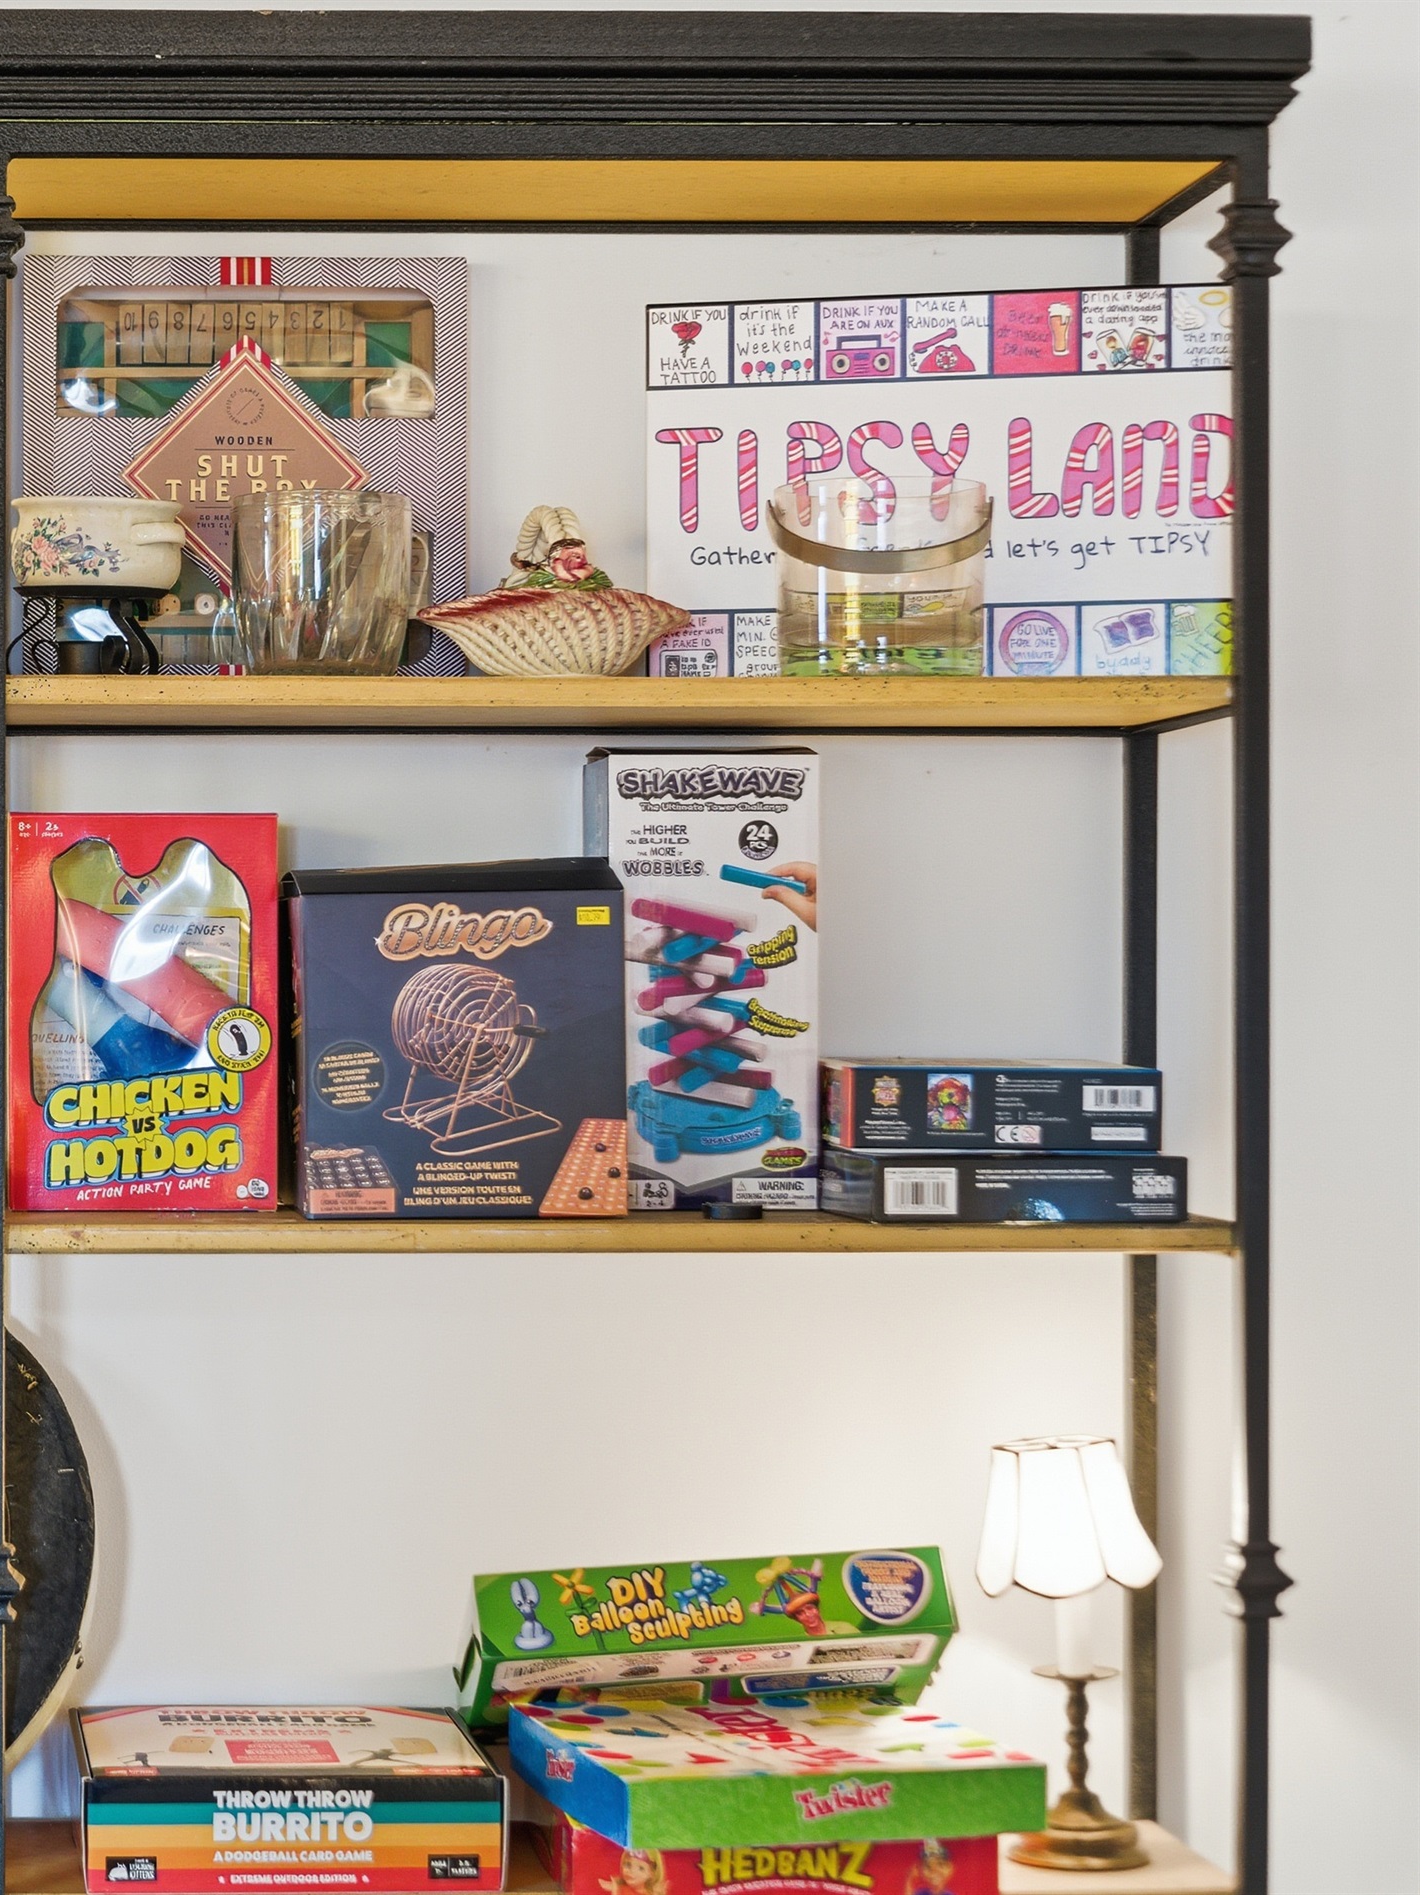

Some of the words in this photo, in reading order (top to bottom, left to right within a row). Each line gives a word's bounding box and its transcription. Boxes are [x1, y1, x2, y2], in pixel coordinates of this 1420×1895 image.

[739, 307, 781, 321] drink
[785, 305, 800, 320] if
[822, 307, 860, 319] DRINK
[864, 305, 875, 317] IF
[876, 305, 898, 316] YOU
[915, 301, 956, 313] MAKE
[958, 300, 968, 312] A
[173, 311, 185, 331] 8
[651, 309, 689, 325] DRINK
[691, 309, 702, 320] IF
[704, 308, 727, 322] YOU
[907, 317, 956, 329] RANDOM
[960, 315, 990, 328] CALL
[1084, 316, 1093, 325] a
[1138, 314, 1159, 327] app
[747, 323, 766, 337] it's
[770, 323, 796, 335] the
[830, 320, 854, 331] ARE
[856, 320, 871, 330] ON
[874, 319, 895, 329] AUX
[660, 357, 698, 371] HAVE
[700, 357, 711, 369] A
[660, 370, 717, 385] TATTOO
[214, 435, 274, 446] WOODEN
[197, 454, 288, 478] SHUT
[655, 419, 970, 534] TIPSY
[1007, 413, 1234, 520] LAND
[164, 479, 231, 502] THE
[690, 544, 778, 567] Gather
[1006, 539, 1059, 559] let's
[1071, 536, 1116, 570] get
[1129, 530, 1211, 557] TIPSY
[736, 615, 771, 627] MAKE
[1017, 623, 1031, 635] GO
[1033, 623, 1055, 635] LIVE
[700, 639, 711, 647] ID
[1010, 638, 1031, 648] FOR
[1033, 637, 1057, 648] ONE
[735, 645, 778, 658] SPEEC
[618, 766, 805, 800] SHAKEWAVE
[639, 802, 660, 812] The
[661, 802, 705, 812] Ultimate
[705, 802, 736, 812] Tower
[737, 801, 789, 813] Challenge
[643, 824, 688, 836] HIGHER
[745, 824, 773, 841] 24
[650, 847, 676, 857] MORE
[152, 923, 226, 936] CHALENGES
[381, 907, 549, 956] Blingo
[746, 925, 798, 957] Gripping
[752, 945, 797, 968] Tension
[47, 1071, 242, 1128] CHICKEN
[131, 1115, 157, 1133] VS
[48, 1126, 242, 1184] HOTDOG
[415, 1162, 423, 1171] A
[423, 1161, 464, 1171] CLASSIC
[464, 1161, 492, 1170] GAME
[492, 1161, 519, 1170] WITH
[417, 1172, 425, 1181] A
[76, 1184, 123, 1202] ACTION
[129, 1180, 173, 1196] PARTY
[178, 1176, 212, 1190] GAME
[412, 1186, 433, 1195] UNE
[433, 1185, 475, 1195] VERSION
[476, 1185, 507, 1194] TOUTE
[507, 1185, 521, 1194] EN
[758, 1181, 805, 1191] WARNING:
[403, 1197, 433, 1206] BLING
[606, 1566, 666, 1607] DIY
[570, 1598, 666, 1637] Balloon
[158, 1714, 372, 1724] BURRITO
[212, 1790, 292, 1809] THROW
[293, 1789, 374, 1809] THROW
[793, 1781, 893, 1821] Twister
[212, 1810, 374, 1843] BURRITO
[213, 1850, 224, 1862] A
[224, 1850, 299, 1863] DODGEBALL
[299, 1849, 334, 1862] CARD
[335, 1849, 374, 1862] GAME
[698, 1841, 874, 1888] HEDBANZ
[229, 1874, 273, 1884] EXTREME
[273, 1873, 319, 1884] OUTDOOR
[319, 1873, 358, 1884] EDITION
